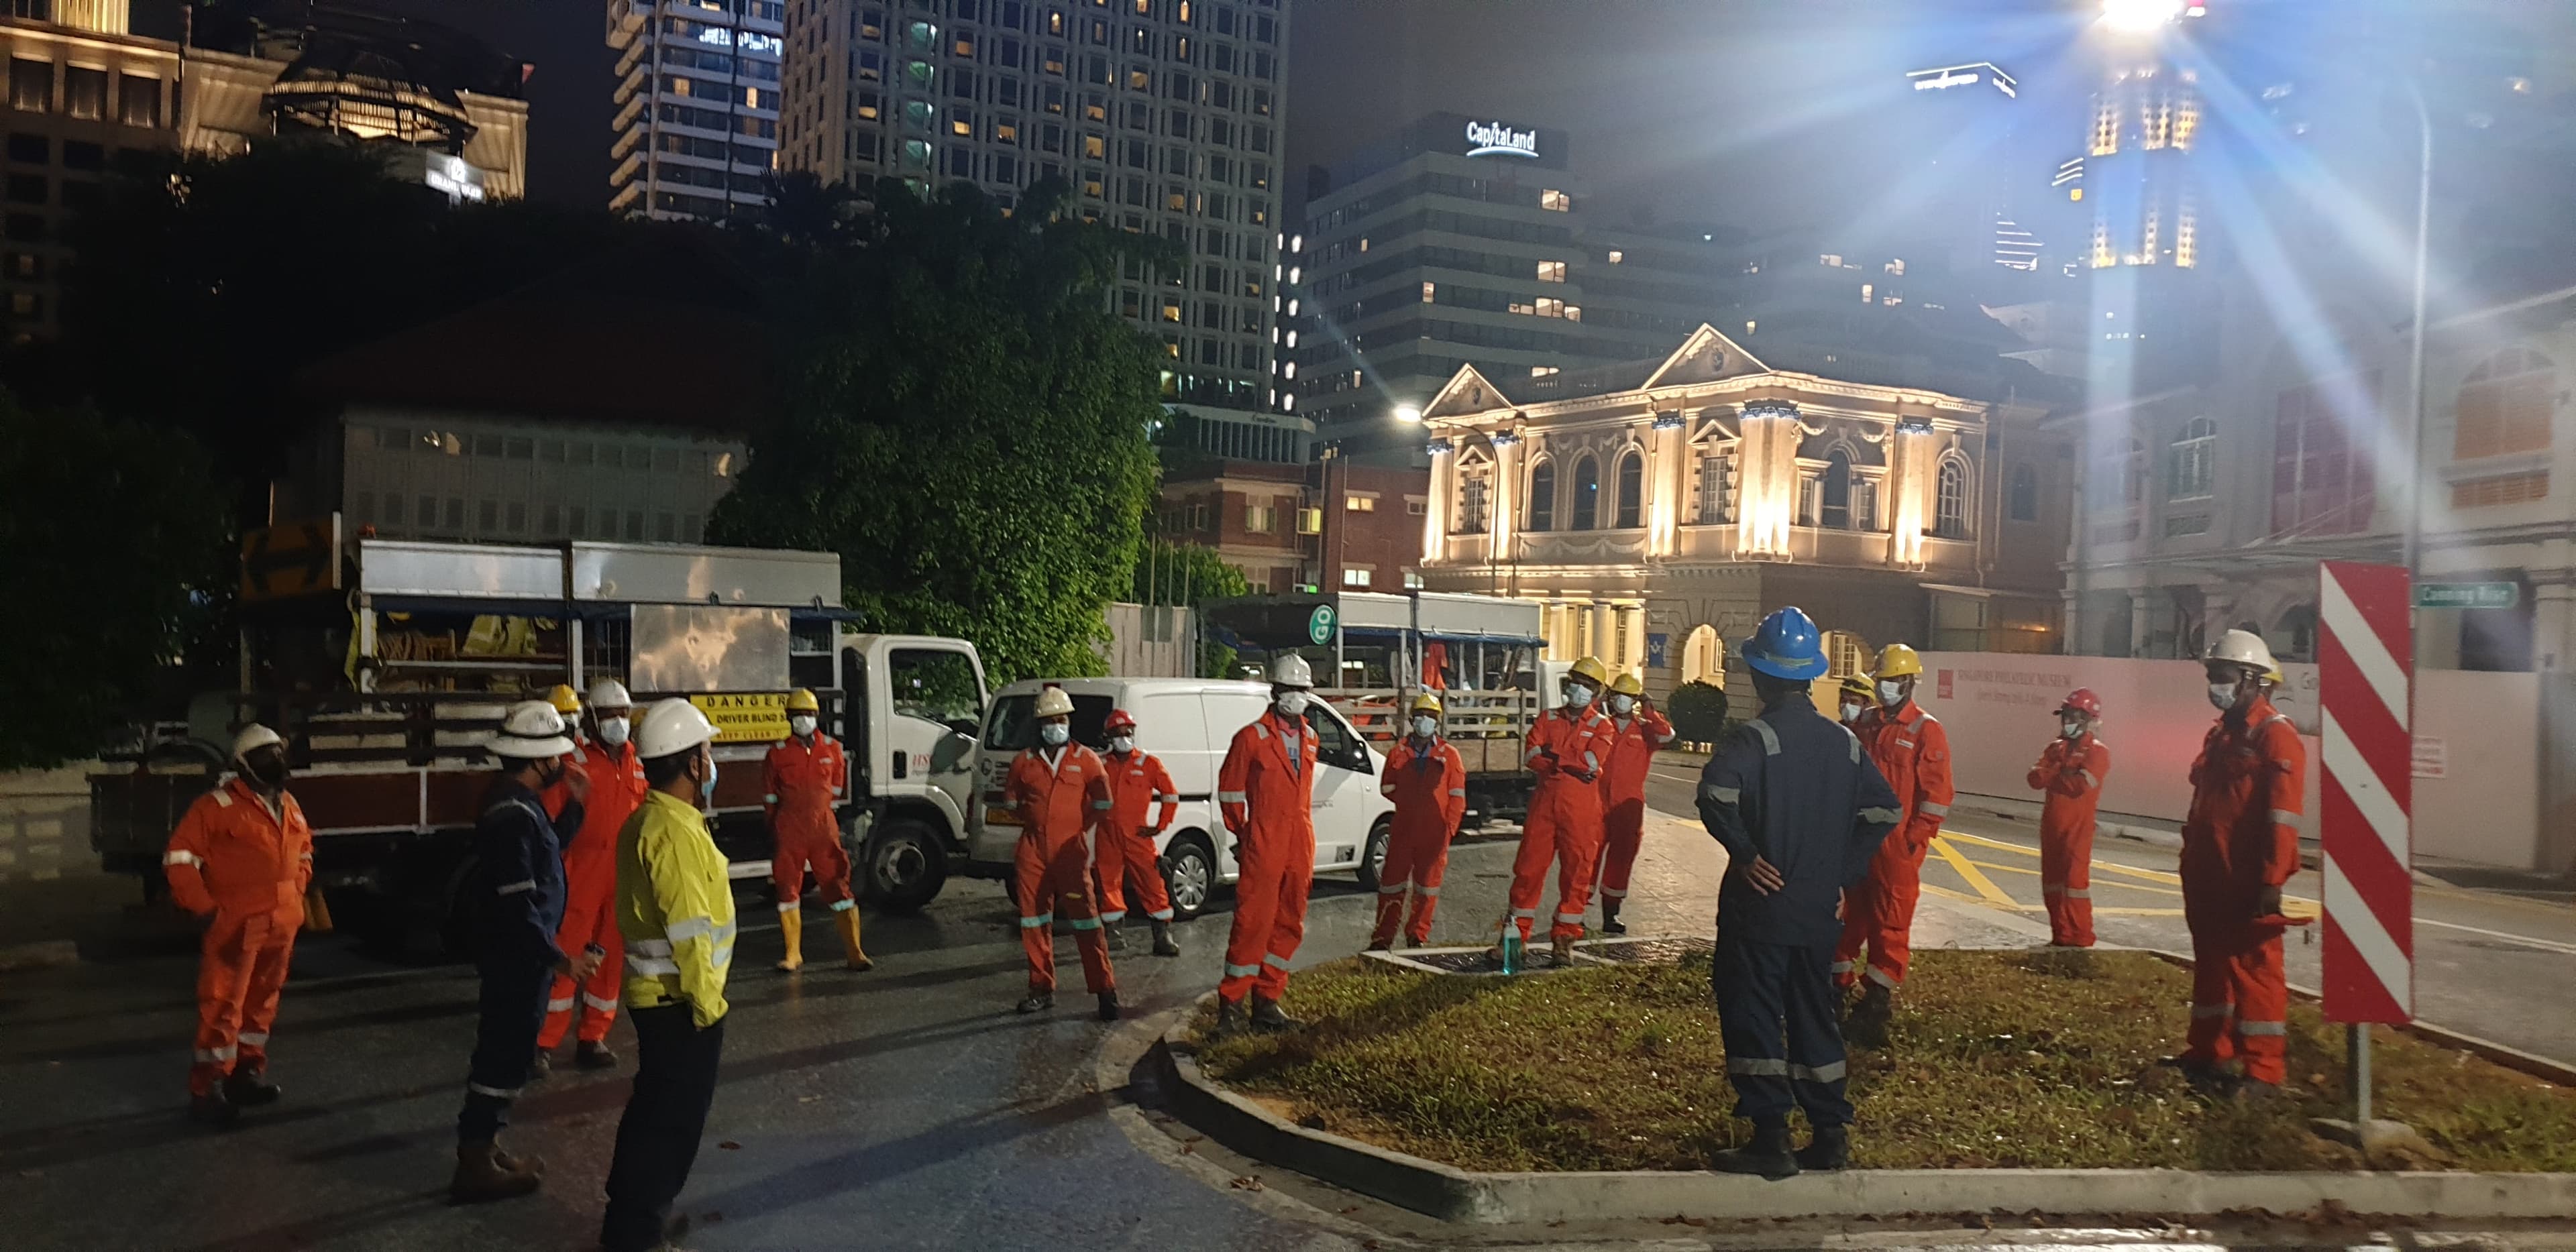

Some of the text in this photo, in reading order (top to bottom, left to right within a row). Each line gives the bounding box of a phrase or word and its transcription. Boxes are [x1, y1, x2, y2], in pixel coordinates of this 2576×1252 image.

[1466, 121, 1536, 152] CapitaLand
[706, 695, 787, 707] DANGER
[716, 713, 749, 724] DRIVER
[751, 713, 778, 724] BLIND
